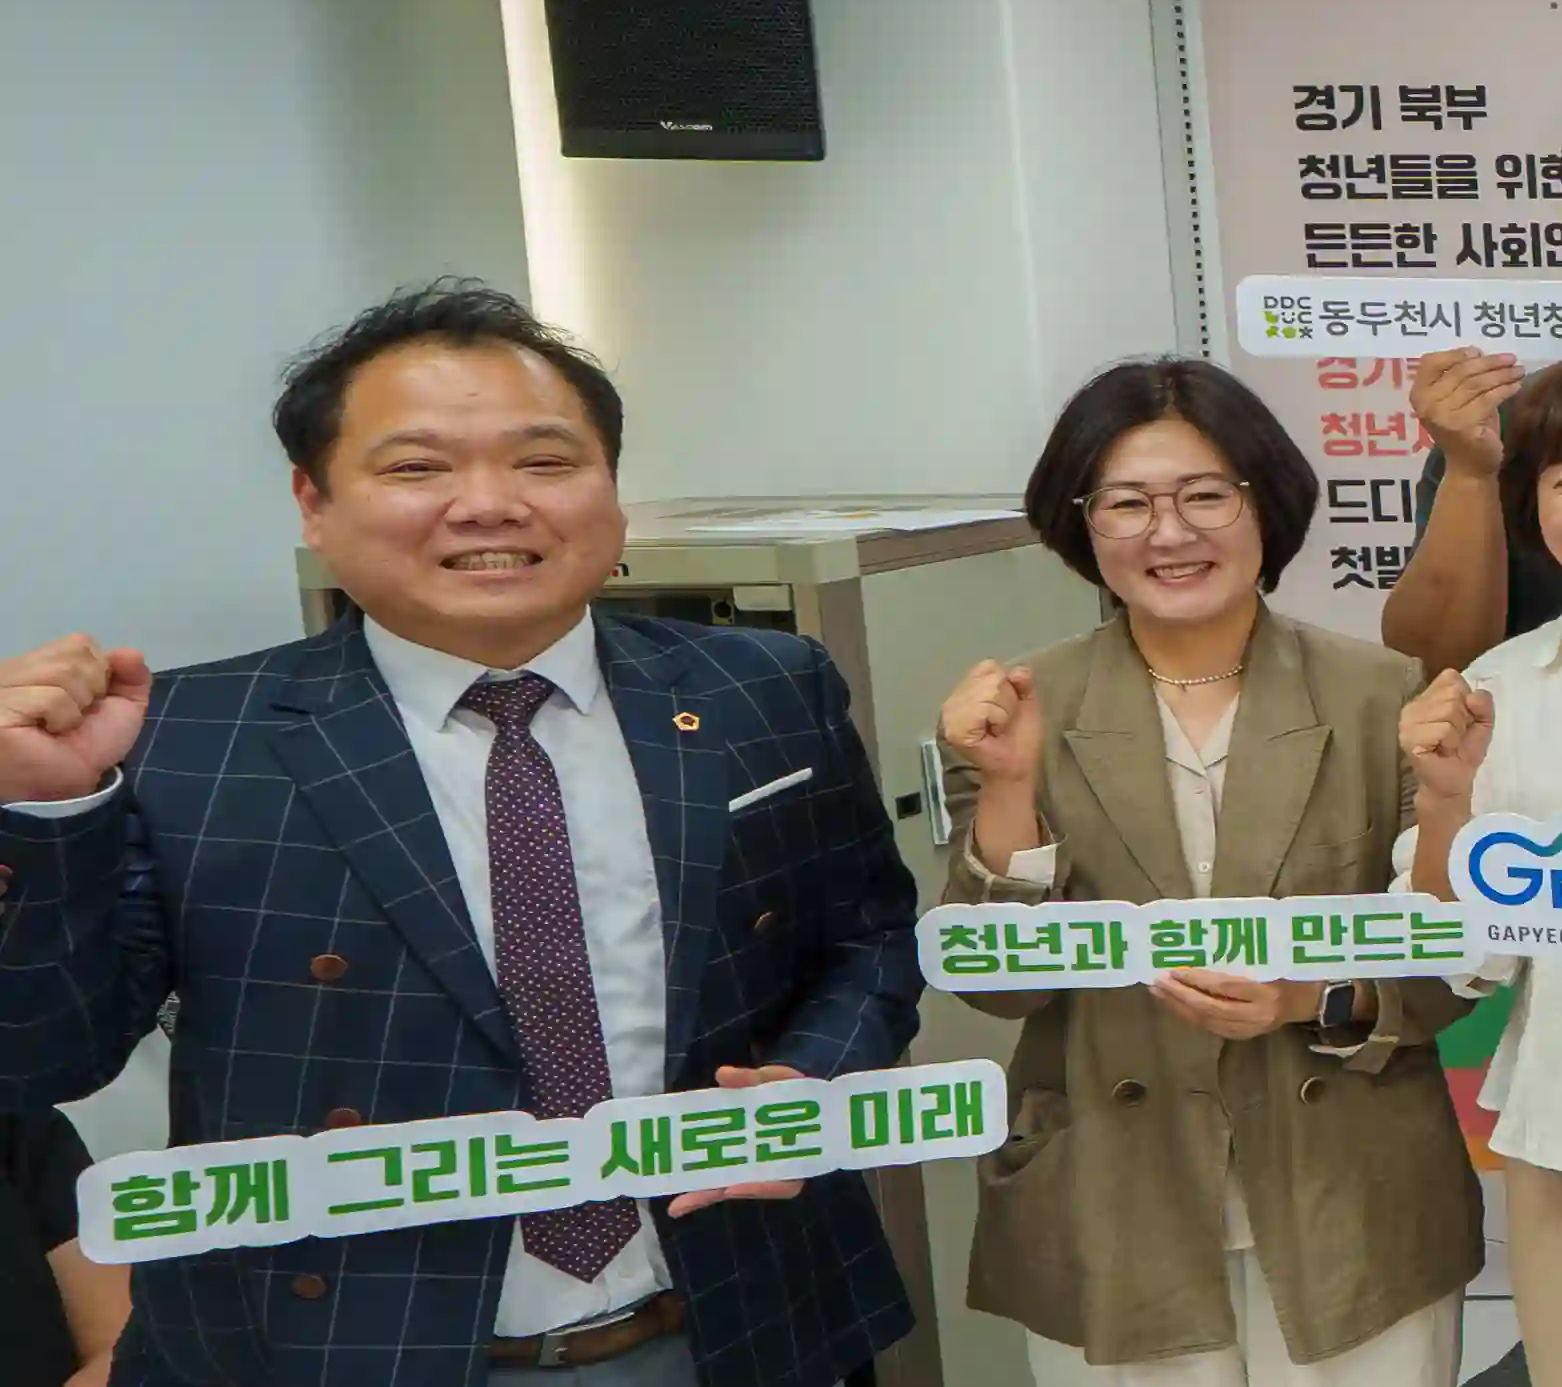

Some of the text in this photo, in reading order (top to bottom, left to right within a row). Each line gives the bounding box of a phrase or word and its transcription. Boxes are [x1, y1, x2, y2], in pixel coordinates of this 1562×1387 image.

[1293, 84, 1488, 130] 경기 북부
[1298, 154, 1480, 199] 청년들을
[1304, 223, 1437, 268] 든든한
[1263, 296, 1312, 309] DDC
[1318, 298, 1462, 339] 동두천시
[1316, 357, 1421, 390] 경기
[939, 911, 1464, 976] 청년과 함께 만드는
[110, 1081, 983, 1242] 함께 그리는 새로운 미래
